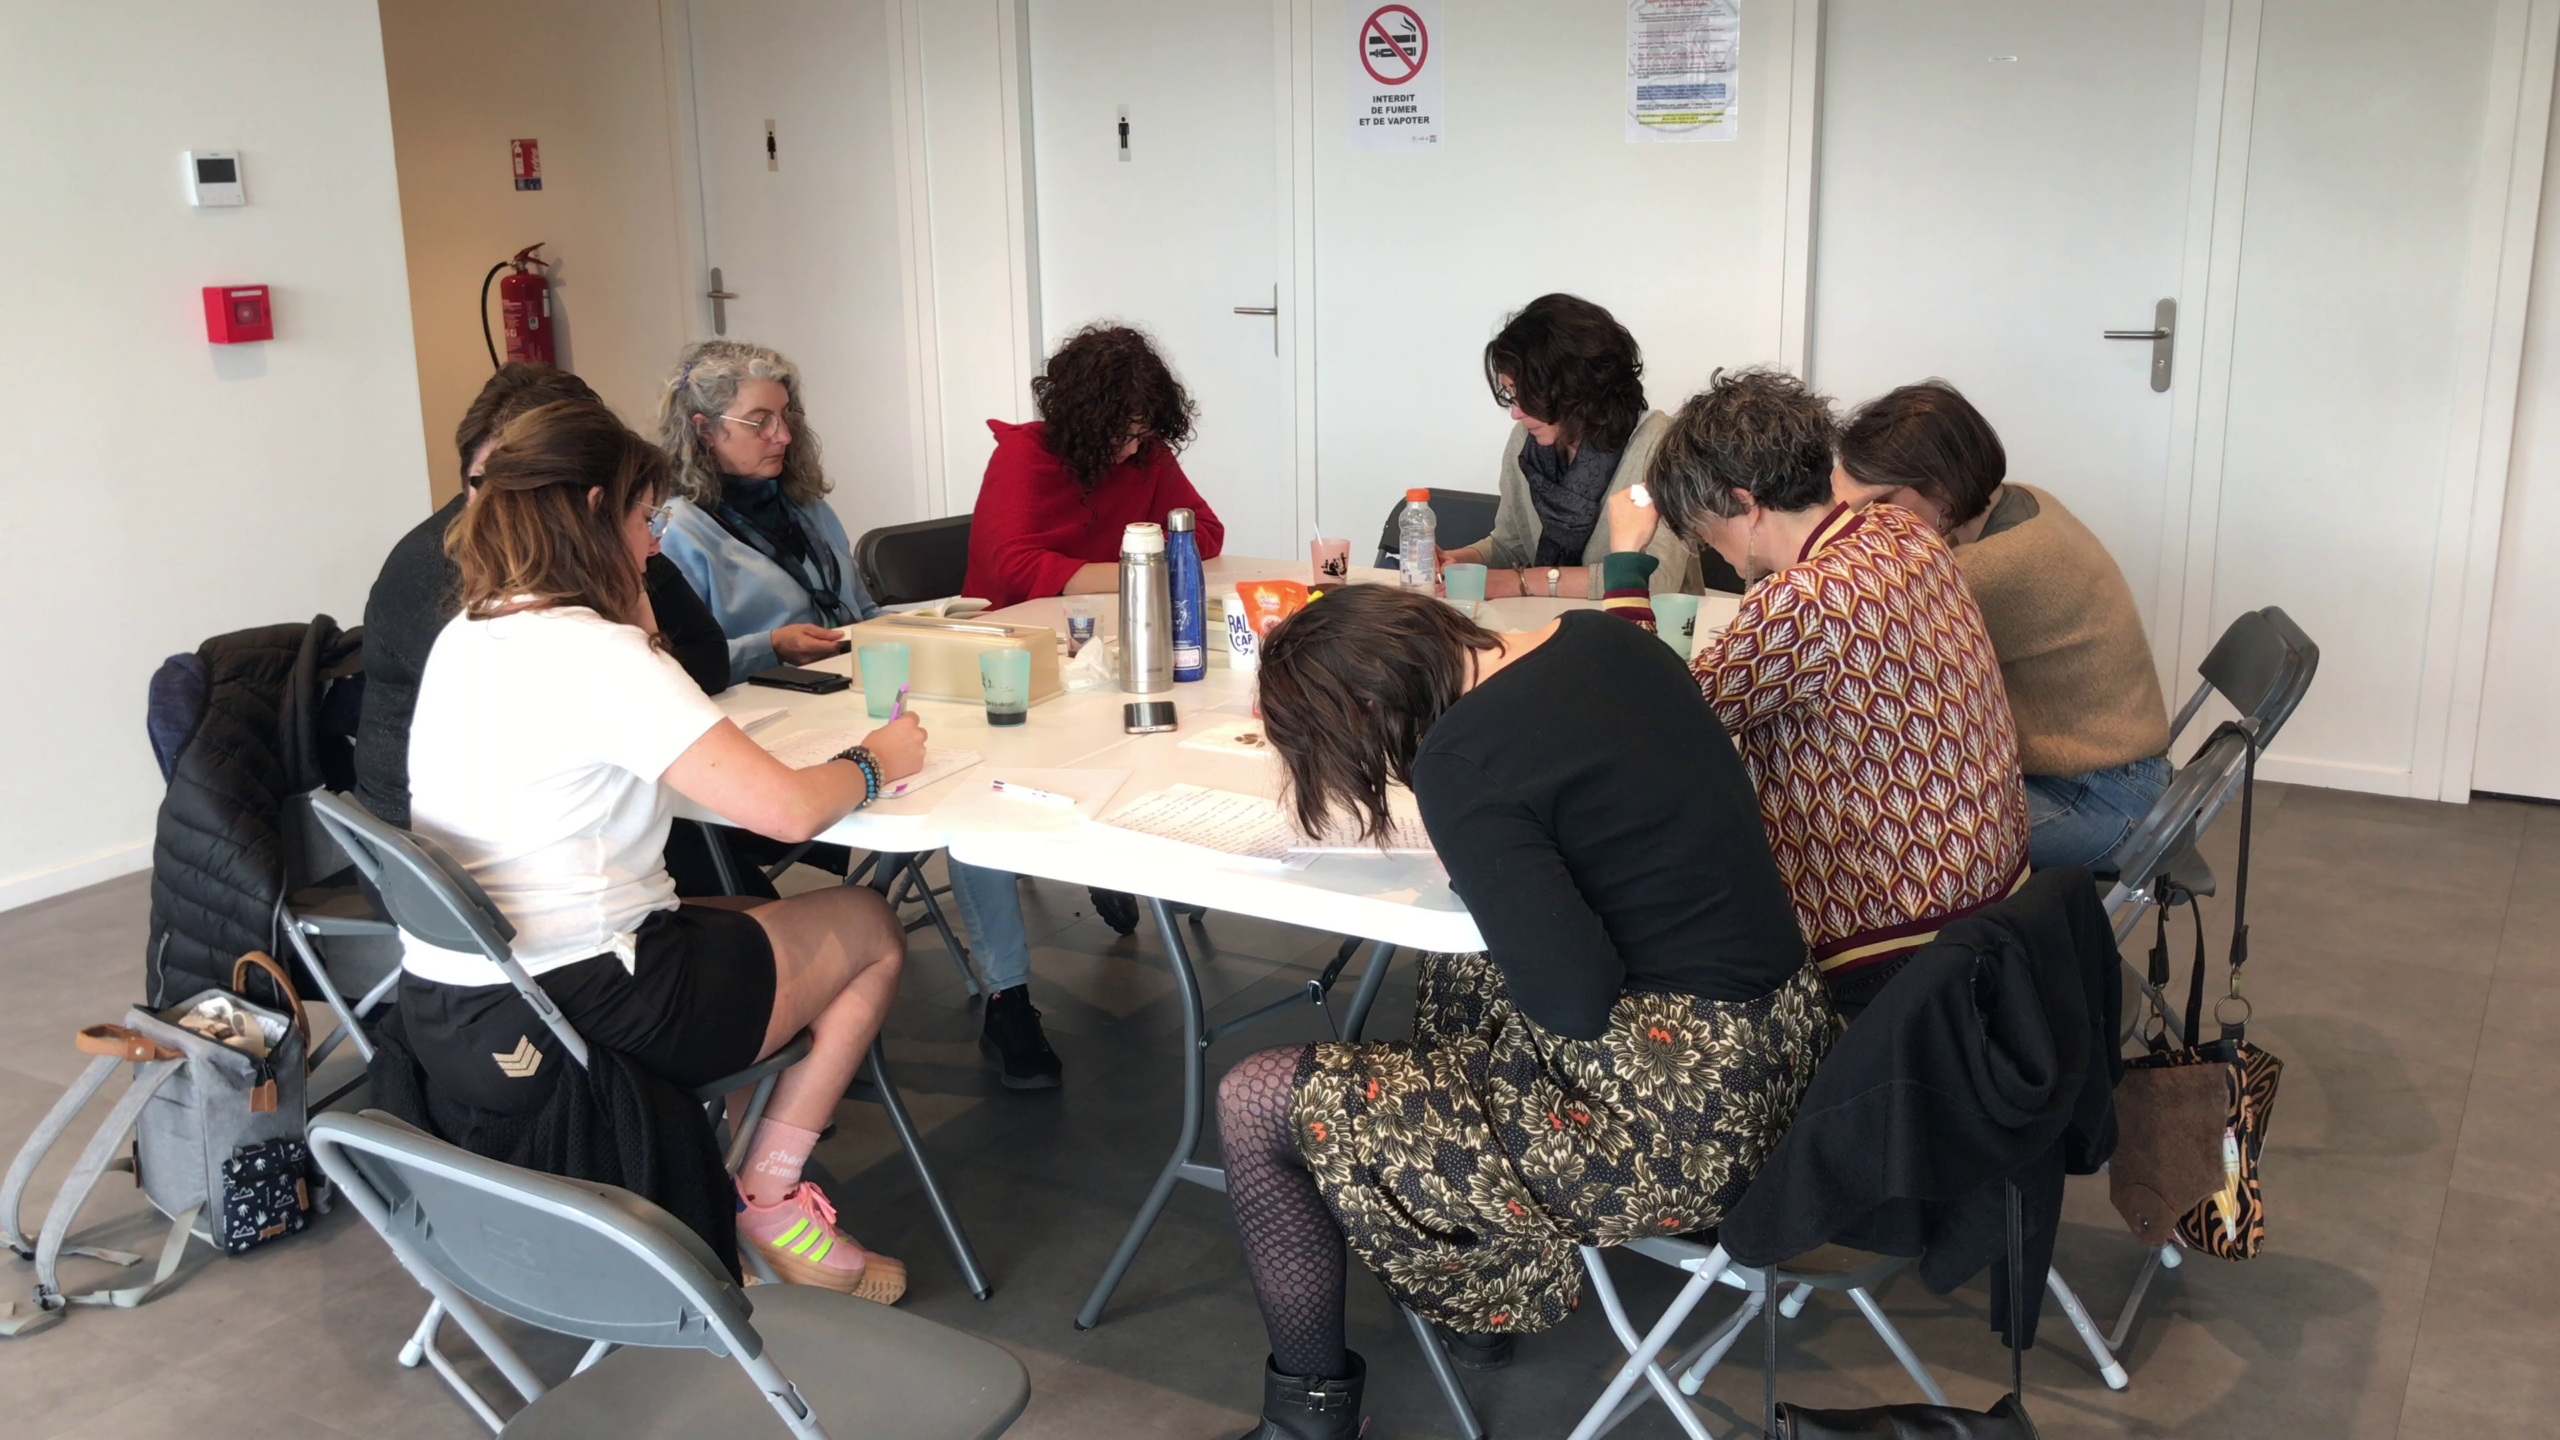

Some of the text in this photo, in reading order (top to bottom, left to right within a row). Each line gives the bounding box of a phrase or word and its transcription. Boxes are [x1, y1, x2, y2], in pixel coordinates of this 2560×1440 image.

[1372, 94, 1416, 103] INTERDIT
[1371, 105, 1418, 115] DE FUMER
[1359, 116, 1430, 126] ET DE VAPOTER
